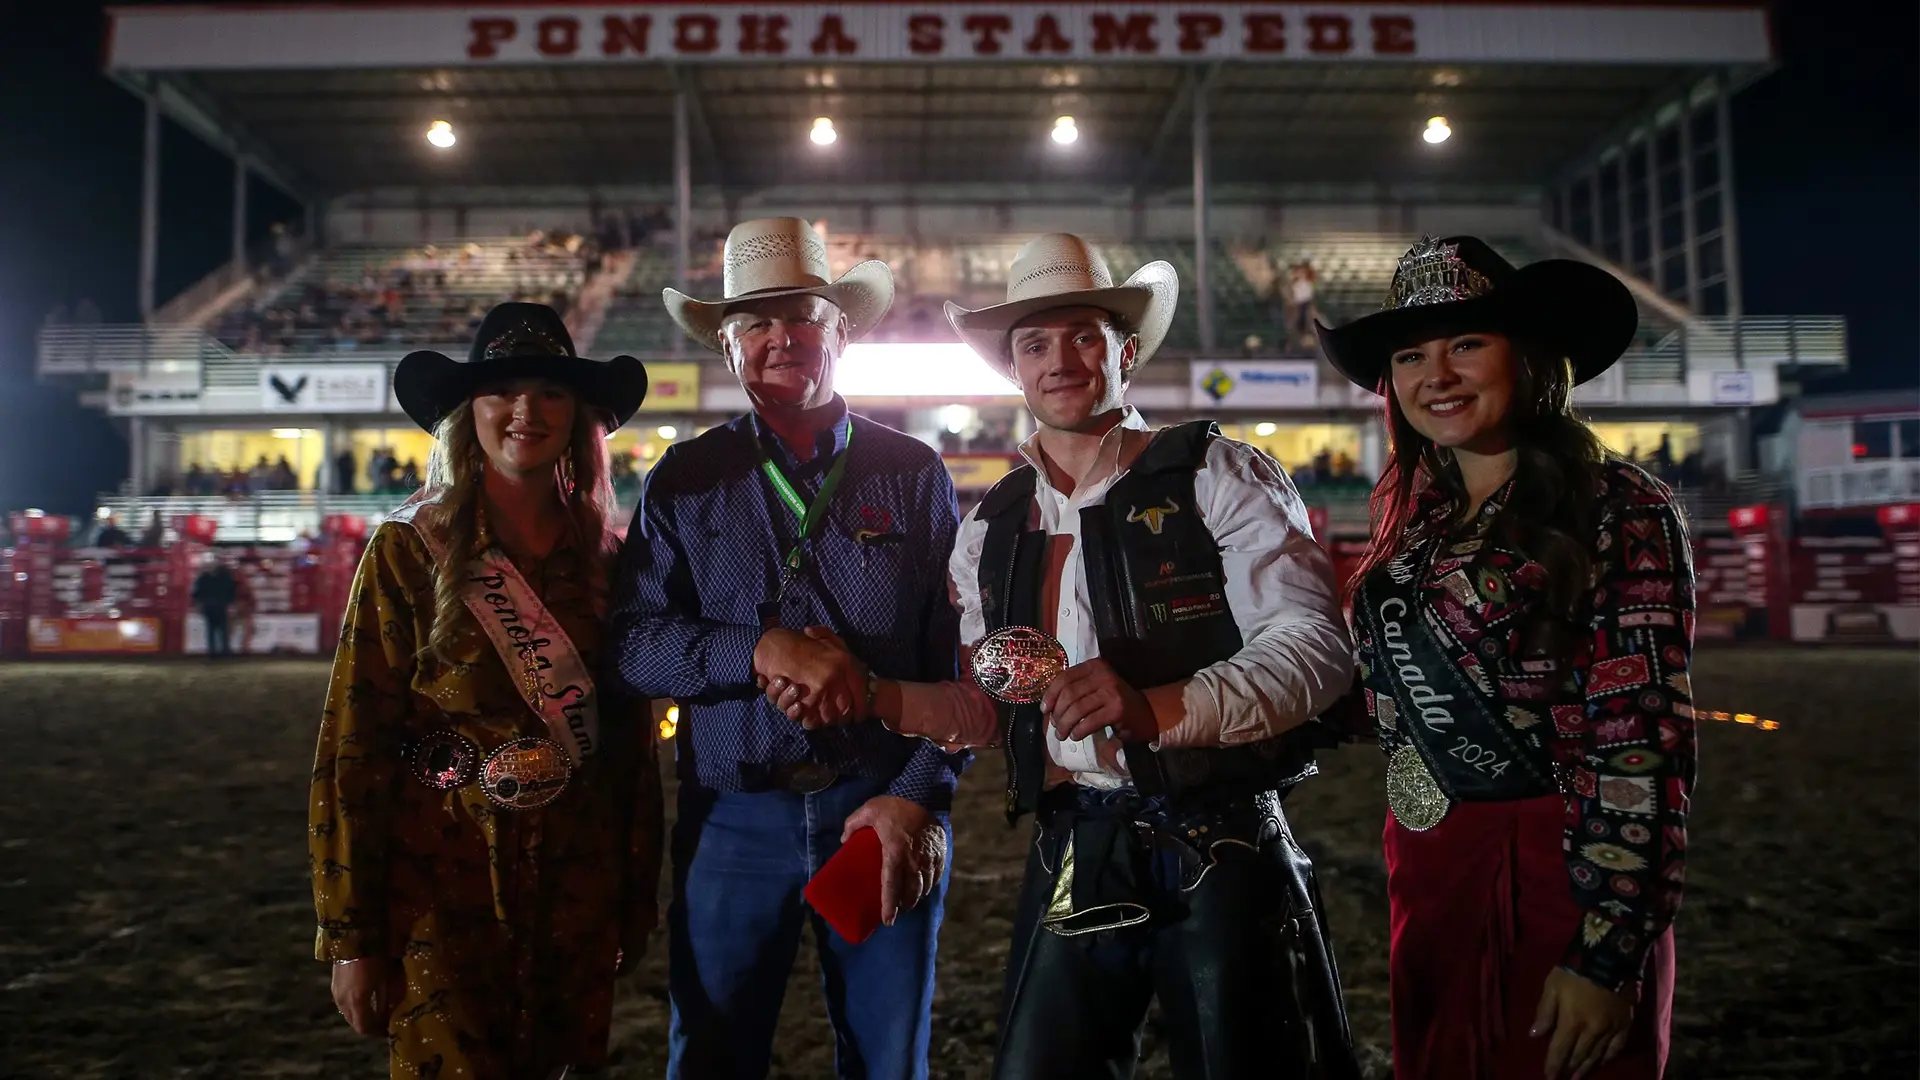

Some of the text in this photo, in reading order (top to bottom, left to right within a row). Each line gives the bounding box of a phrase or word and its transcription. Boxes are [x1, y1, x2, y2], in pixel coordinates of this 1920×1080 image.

[467, 12, 1418, 58] PONOKA STAMPEDE
[1380, 597, 1454, 733] Canada
[1447, 736, 1511, 780] 2024
